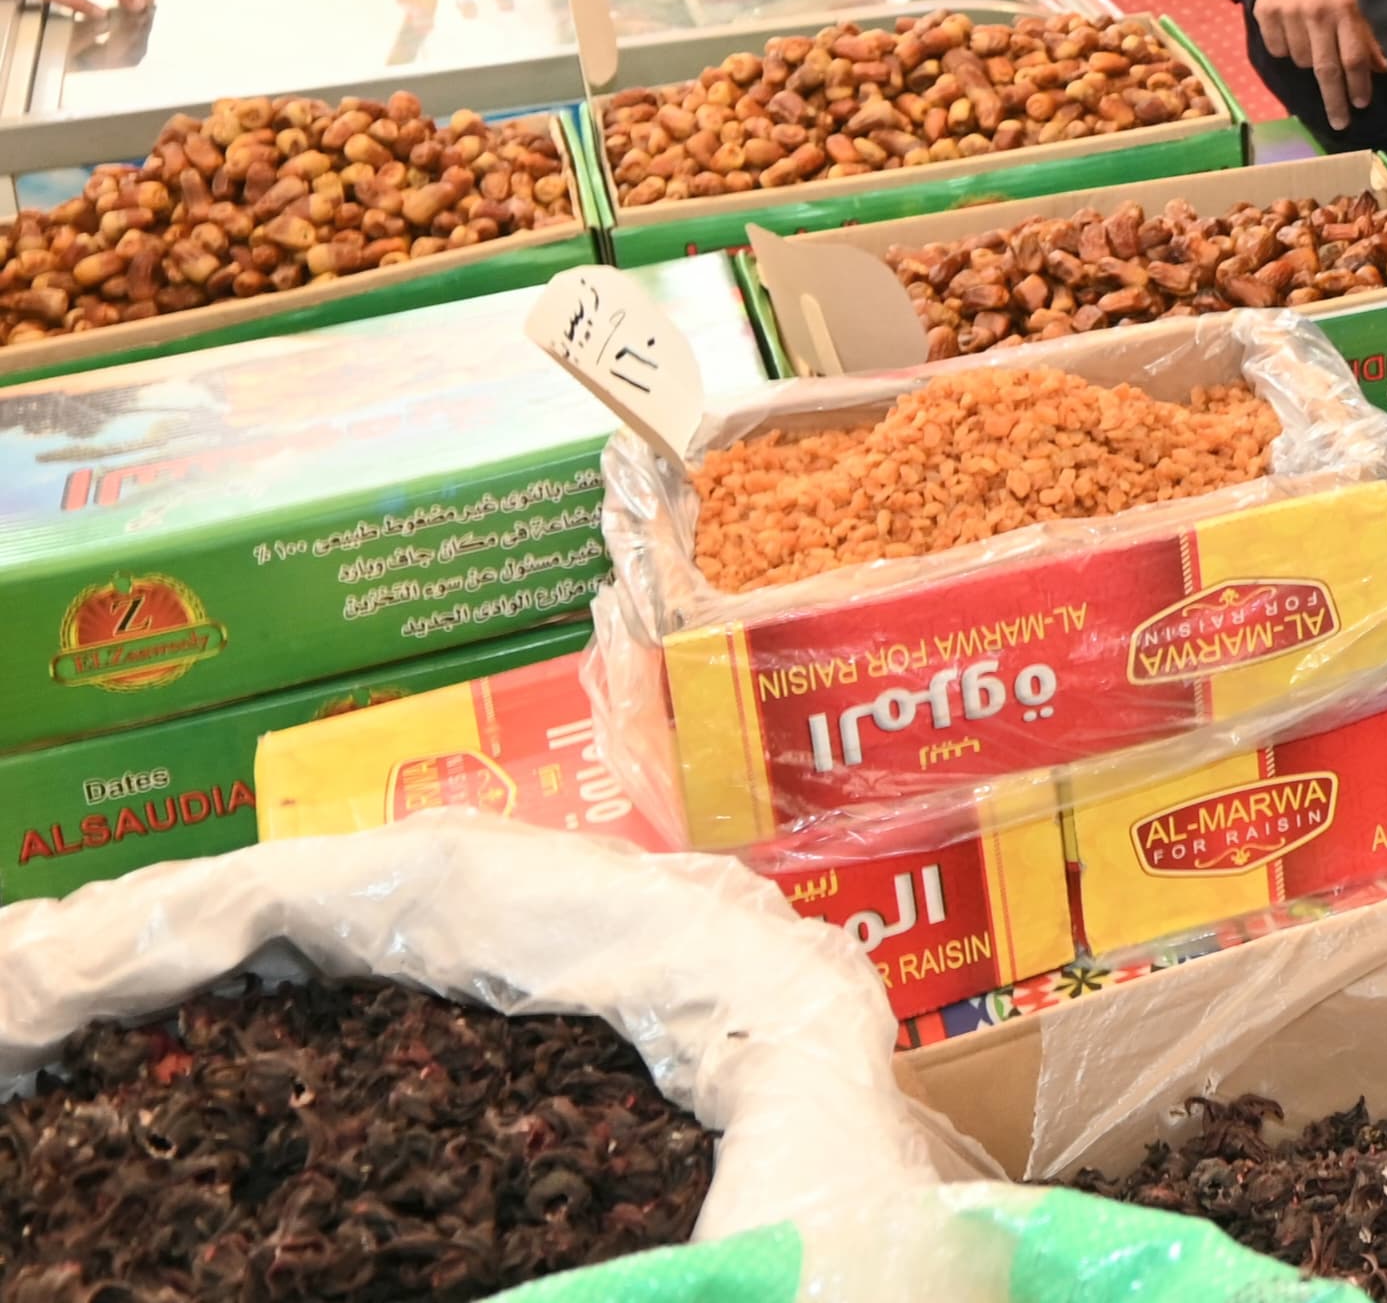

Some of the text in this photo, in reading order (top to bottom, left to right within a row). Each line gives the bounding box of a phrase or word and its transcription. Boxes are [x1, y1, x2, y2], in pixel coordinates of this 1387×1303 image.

[457, 494, 498, 523] غير
[501, 479, 562, 514] بالنوى
[382, 506, 455, 536] مضغوط
[530, 502, 602, 541] لبضاعة
[387, 545, 434, 571] جاف
[438, 529, 498, 563] مكان
[560, 537, 602, 568] غير
[338, 554, 386, 583] وبارد
[464, 569, 496, 592] عن
[343, 582, 419, 619] التخزين
[423, 575, 463, 601] سوء
[535, 580, 584, 610] مزارع
[110, 595, 152, 636] Z
[402, 606, 470, 637] الجديد
[1144, 591, 1318, 646] FOR RAISIN
[758, 602, 1087, 702] AL-MARWA FOR RAISIN
[1139, 608, 1325, 676] AL-MARWA
[808, 660, 1057, 773] المروة
[919, 736, 980, 770] زبيب
[83, 767, 170, 805] Dates
[18, 779, 256, 865] ALSAUDIA
[1146, 780, 1327, 849] AL-MARWA
[1153, 809, 1321, 864] FOR RAISIN
[900, 931, 991, 984] RAISIN
